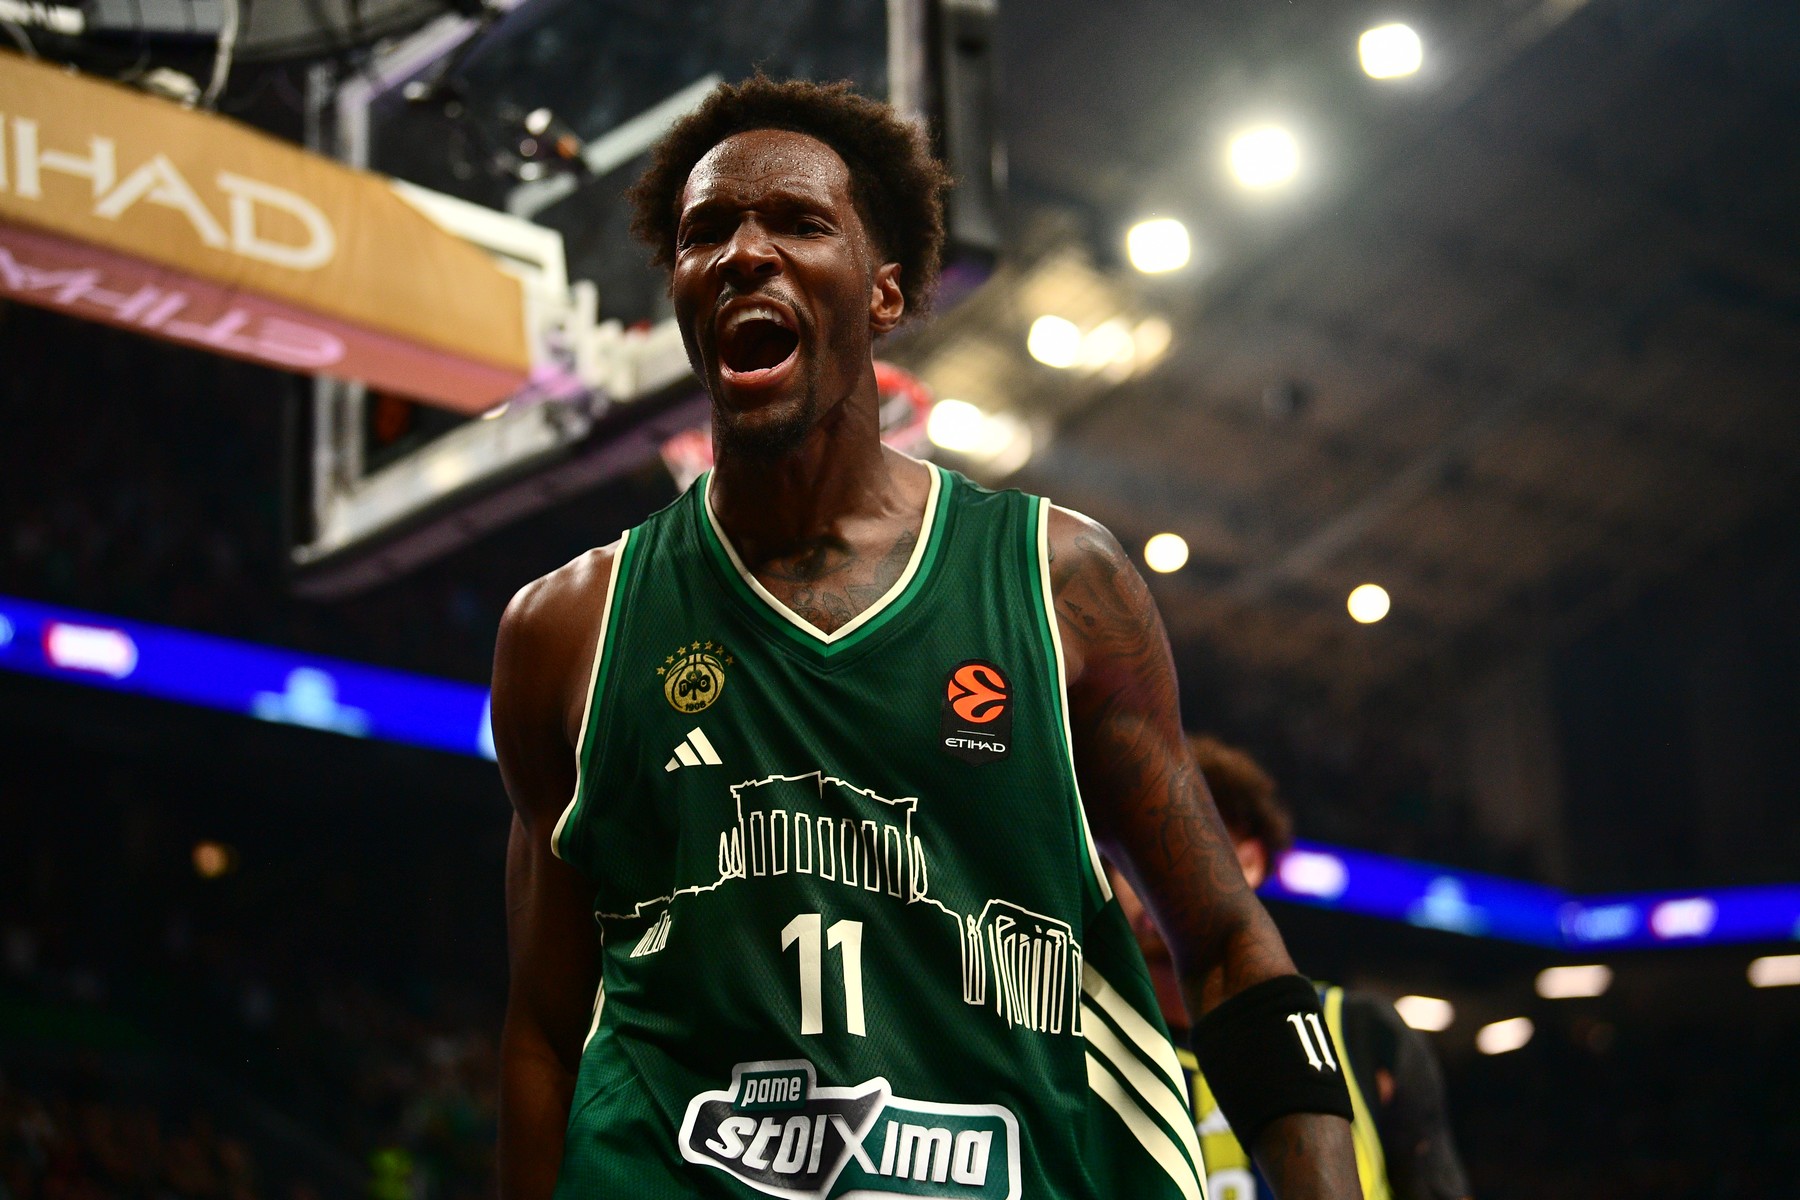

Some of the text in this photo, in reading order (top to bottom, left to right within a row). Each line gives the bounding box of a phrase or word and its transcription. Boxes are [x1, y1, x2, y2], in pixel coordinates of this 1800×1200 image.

[0, 111, 337, 270] HAD
[944, 737, 1006, 753] ETIHAD
[780, 913, 867, 1037] 11
[1286, 1012, 1337, 1073] 11
[740, 1073, 802, 1108] pame
